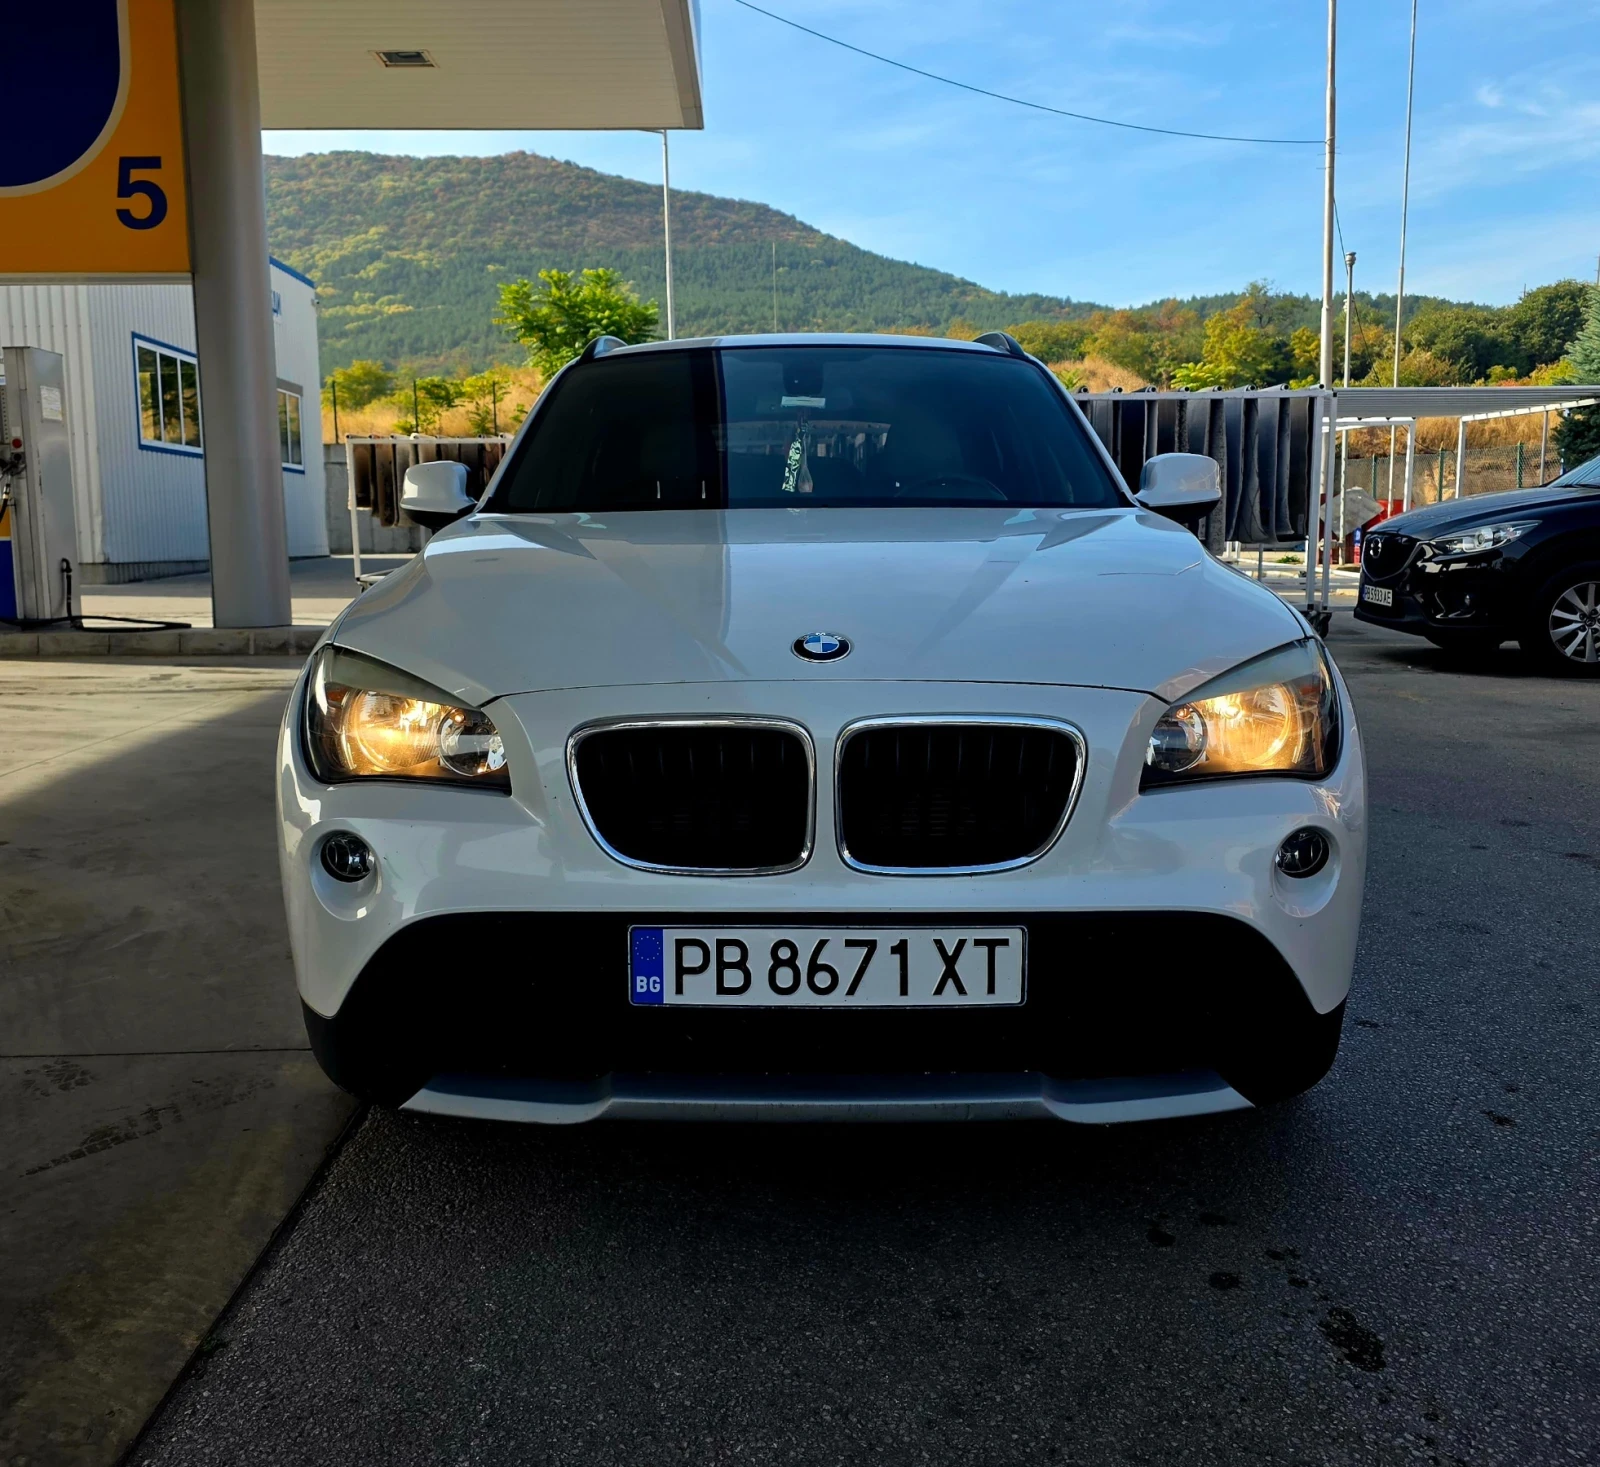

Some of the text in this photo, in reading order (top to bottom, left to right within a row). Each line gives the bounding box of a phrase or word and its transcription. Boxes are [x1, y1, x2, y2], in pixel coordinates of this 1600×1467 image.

[116, 156, 167, 230] 5
[636, 976, 660, 992] BG
[675, 938, 1010, 996] PB 8671 XT
